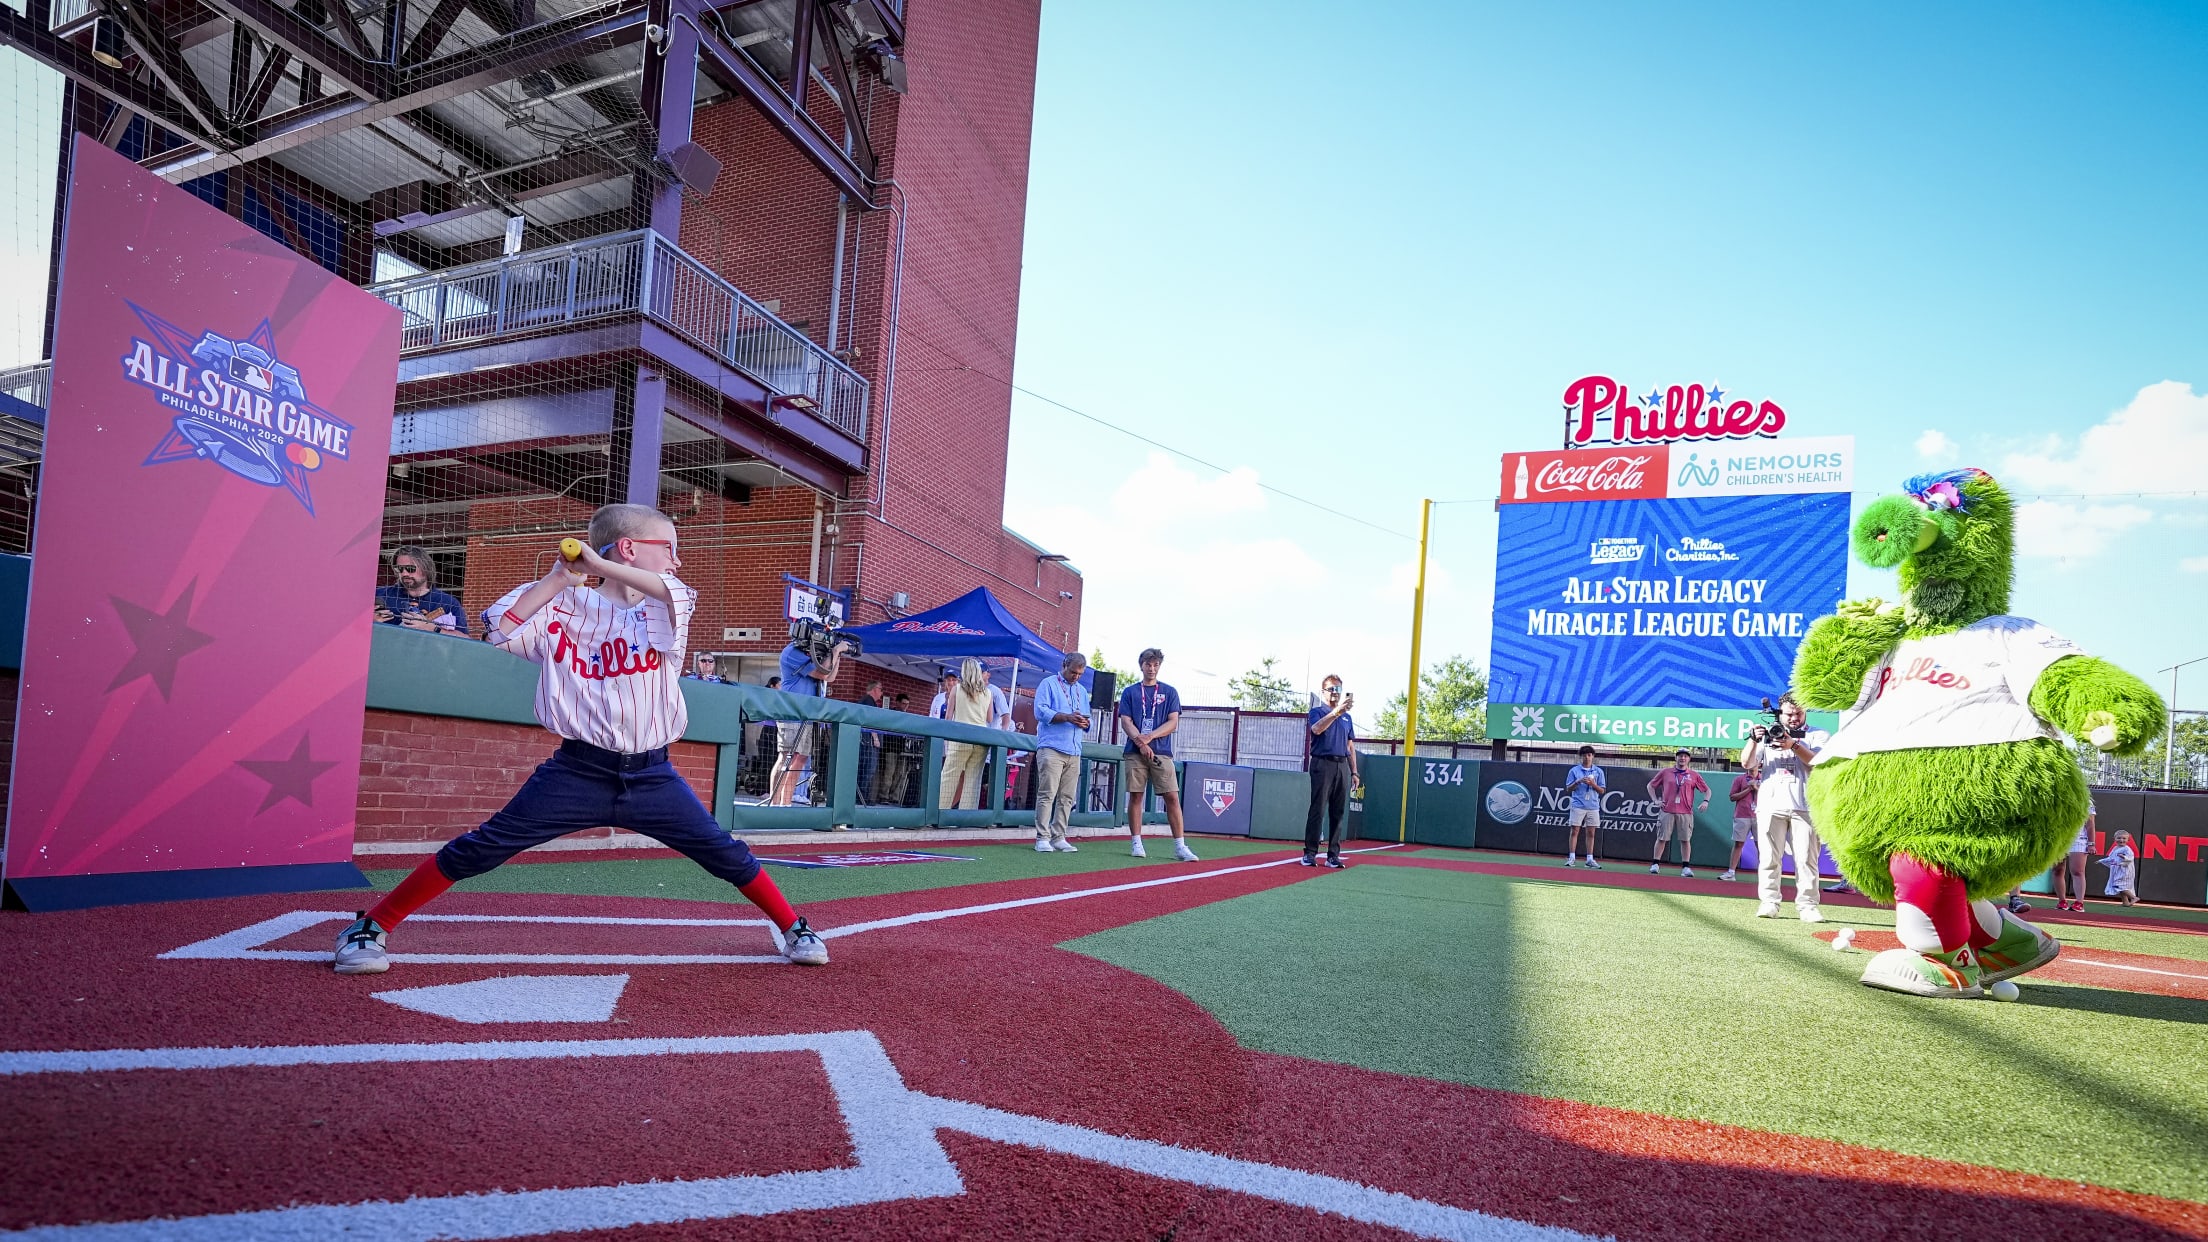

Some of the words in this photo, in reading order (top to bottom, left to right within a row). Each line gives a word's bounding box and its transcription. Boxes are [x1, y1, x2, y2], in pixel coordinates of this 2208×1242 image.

[125, 341, 193, 398] ALL
[198, 369, 273, 429] STAR
[278, 400, 349, 456] GAME
[1563, 375, 1786, 443] Phillies
[161, 392, 249, 433] PHILADELPHIA
[257, 428, 285, 446] 2026
[1535, 456, 1652, 493] Coca-Cola
[1727, 452, 1843, 472] NEMOURS
[1726, 473, 1794, 486] CHILDREN'S
[1797, 471, 1843, 484] HEALTH
[1590, 542, 1646, 560] Legacy
[1681, 536, 1725, 552] Phillies
[1562, 576, 1608, 604] ALL
[1610, 576, 1669, 604] STAR
[1674, 575, 1768, 604] LEGACY
[1526, 608, 1628, 636] MIRACLE
[1632, 608, 1727, 637] LEAGUE
[1732, 608, 1804, 637] GAME
[547, 621, 662, 681] Phillie
[1876, 657, 1971, 700] Pllies
[1554, 712, 1656, 738] Citizens
[1663, 714, 1730, 740] Bank
[1205, 780, 1235, 793] MLB
[1424, 762, 1464, 786] 334
[1534, 814, 1657, 833] REHATATION
